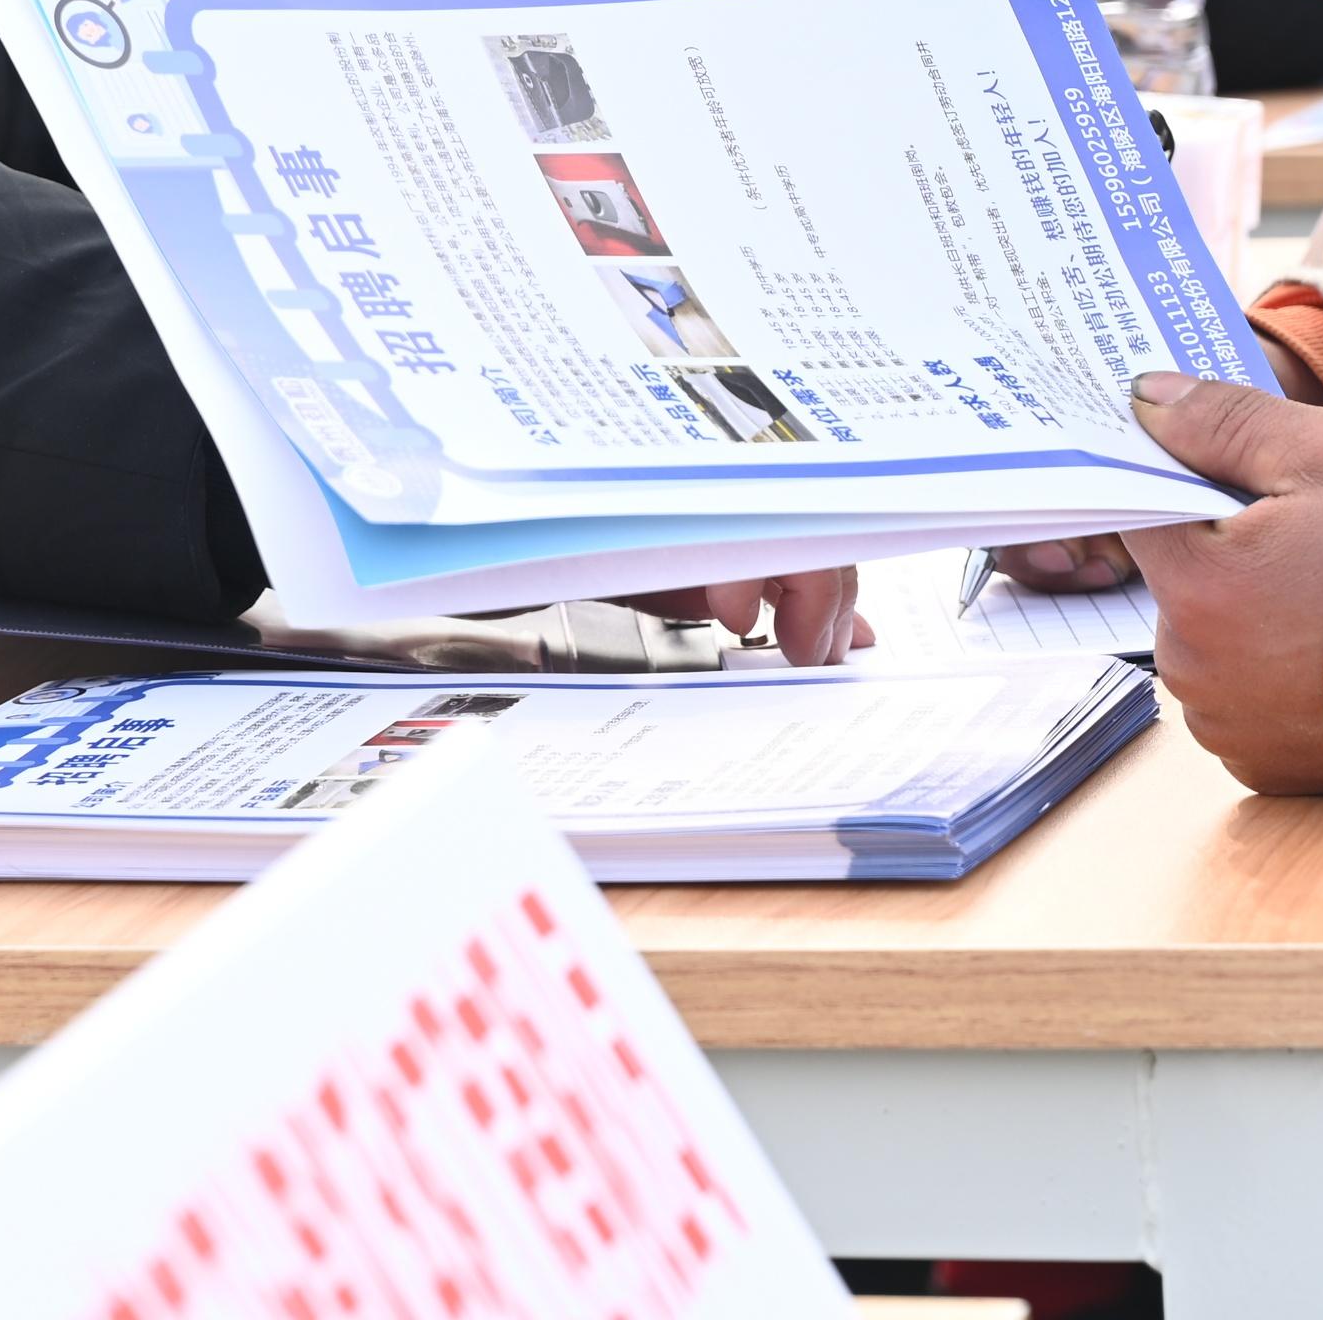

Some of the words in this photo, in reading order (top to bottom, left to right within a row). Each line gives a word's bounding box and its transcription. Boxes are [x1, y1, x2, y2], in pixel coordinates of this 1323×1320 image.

[1061, 86, 1145, 231] 15996025959
[260, 143, 459, 375] 招聘启事
[974, 69, 1137, 409] 们诚聘肯吃苦、想赚钱的年轻人！
[1026, 118, 1154, 355] 泰州劲松期待您的加入！
[1145, 270, 1221, 381] 961011133
[475, 364, 562, 445] 公司简介
[626, 362, 716, 441] 产品展示
[770, 368, 862, 441] 岗位需求
[919, 359, 1013, 429] 需求人数
[971, 355, 1064, 429] 工资待遇
[28, 718, 176, 786] 招聘启事
